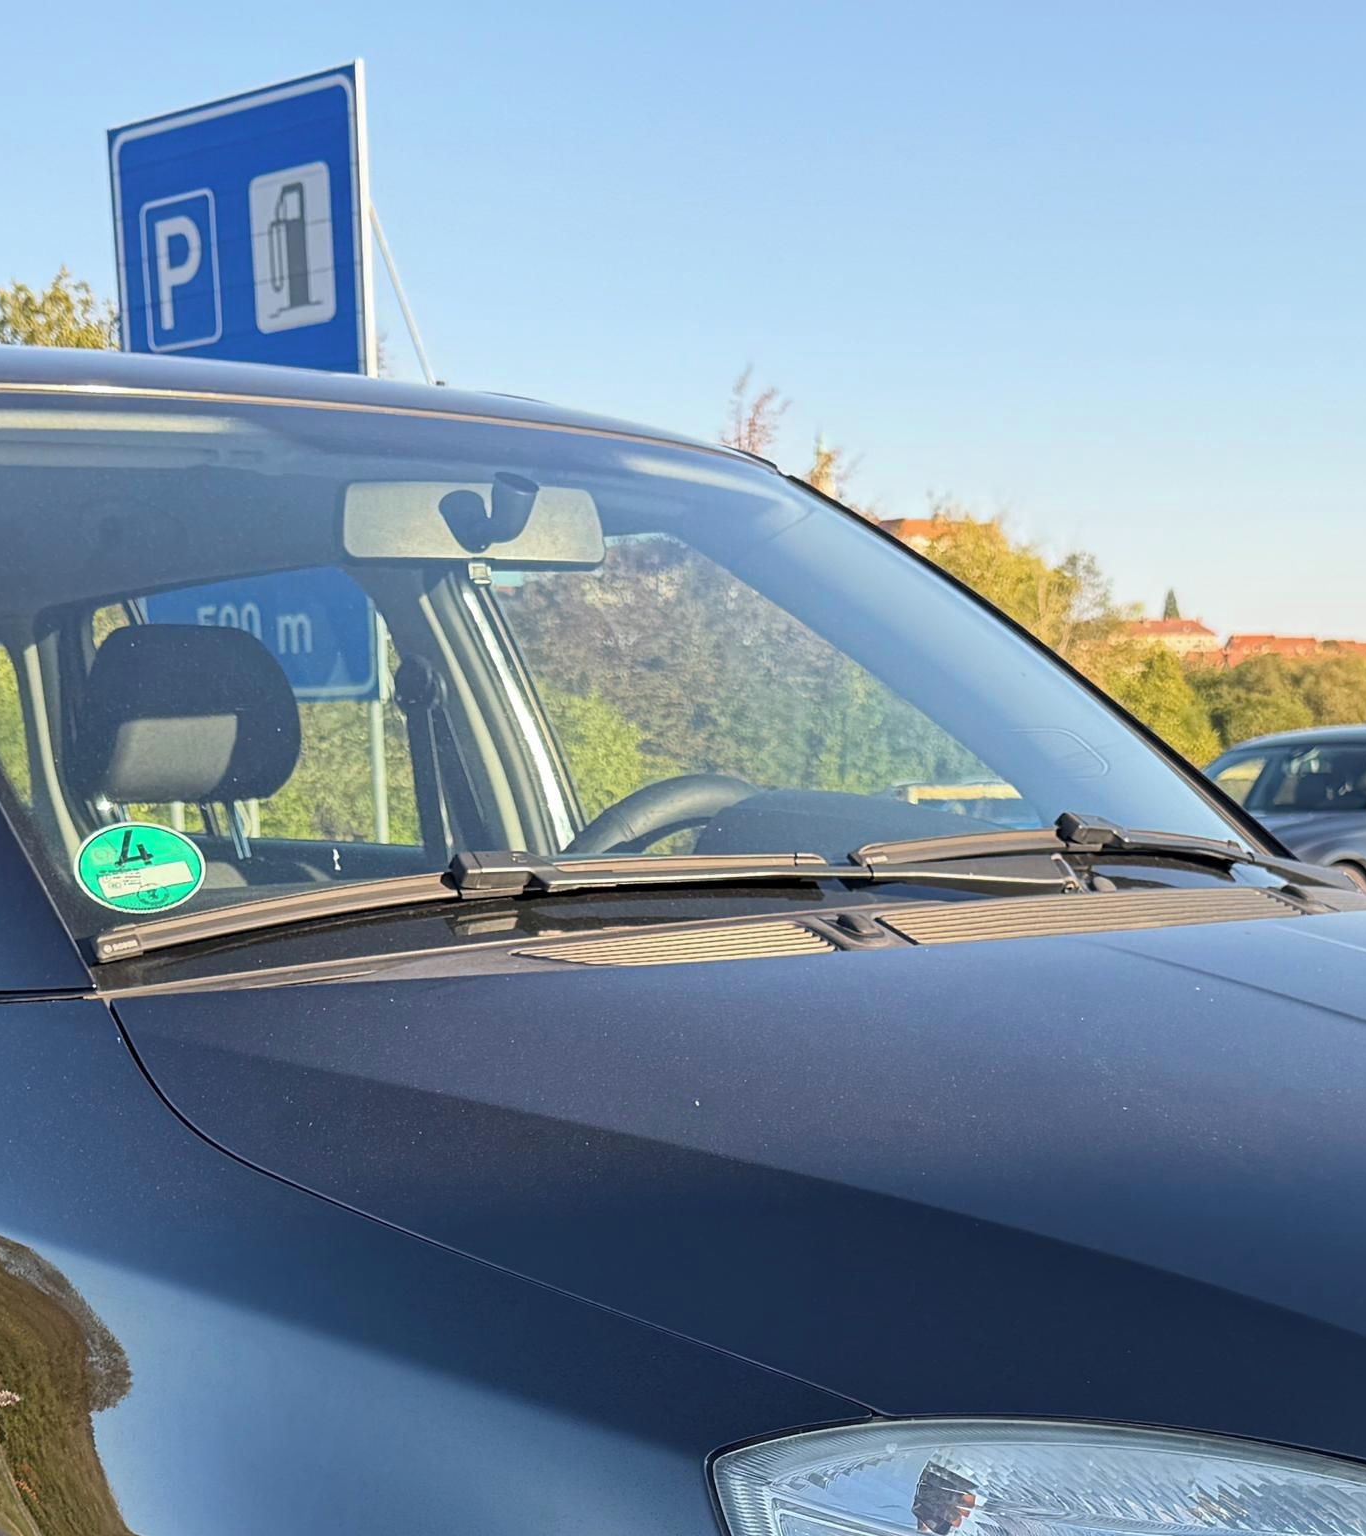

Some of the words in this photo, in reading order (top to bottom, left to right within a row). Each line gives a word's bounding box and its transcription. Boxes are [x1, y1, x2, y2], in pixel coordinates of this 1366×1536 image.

[154, 215, 202, 331] P
[277, 613, 313, 655] m
[114, 829, 154, 867] 4
